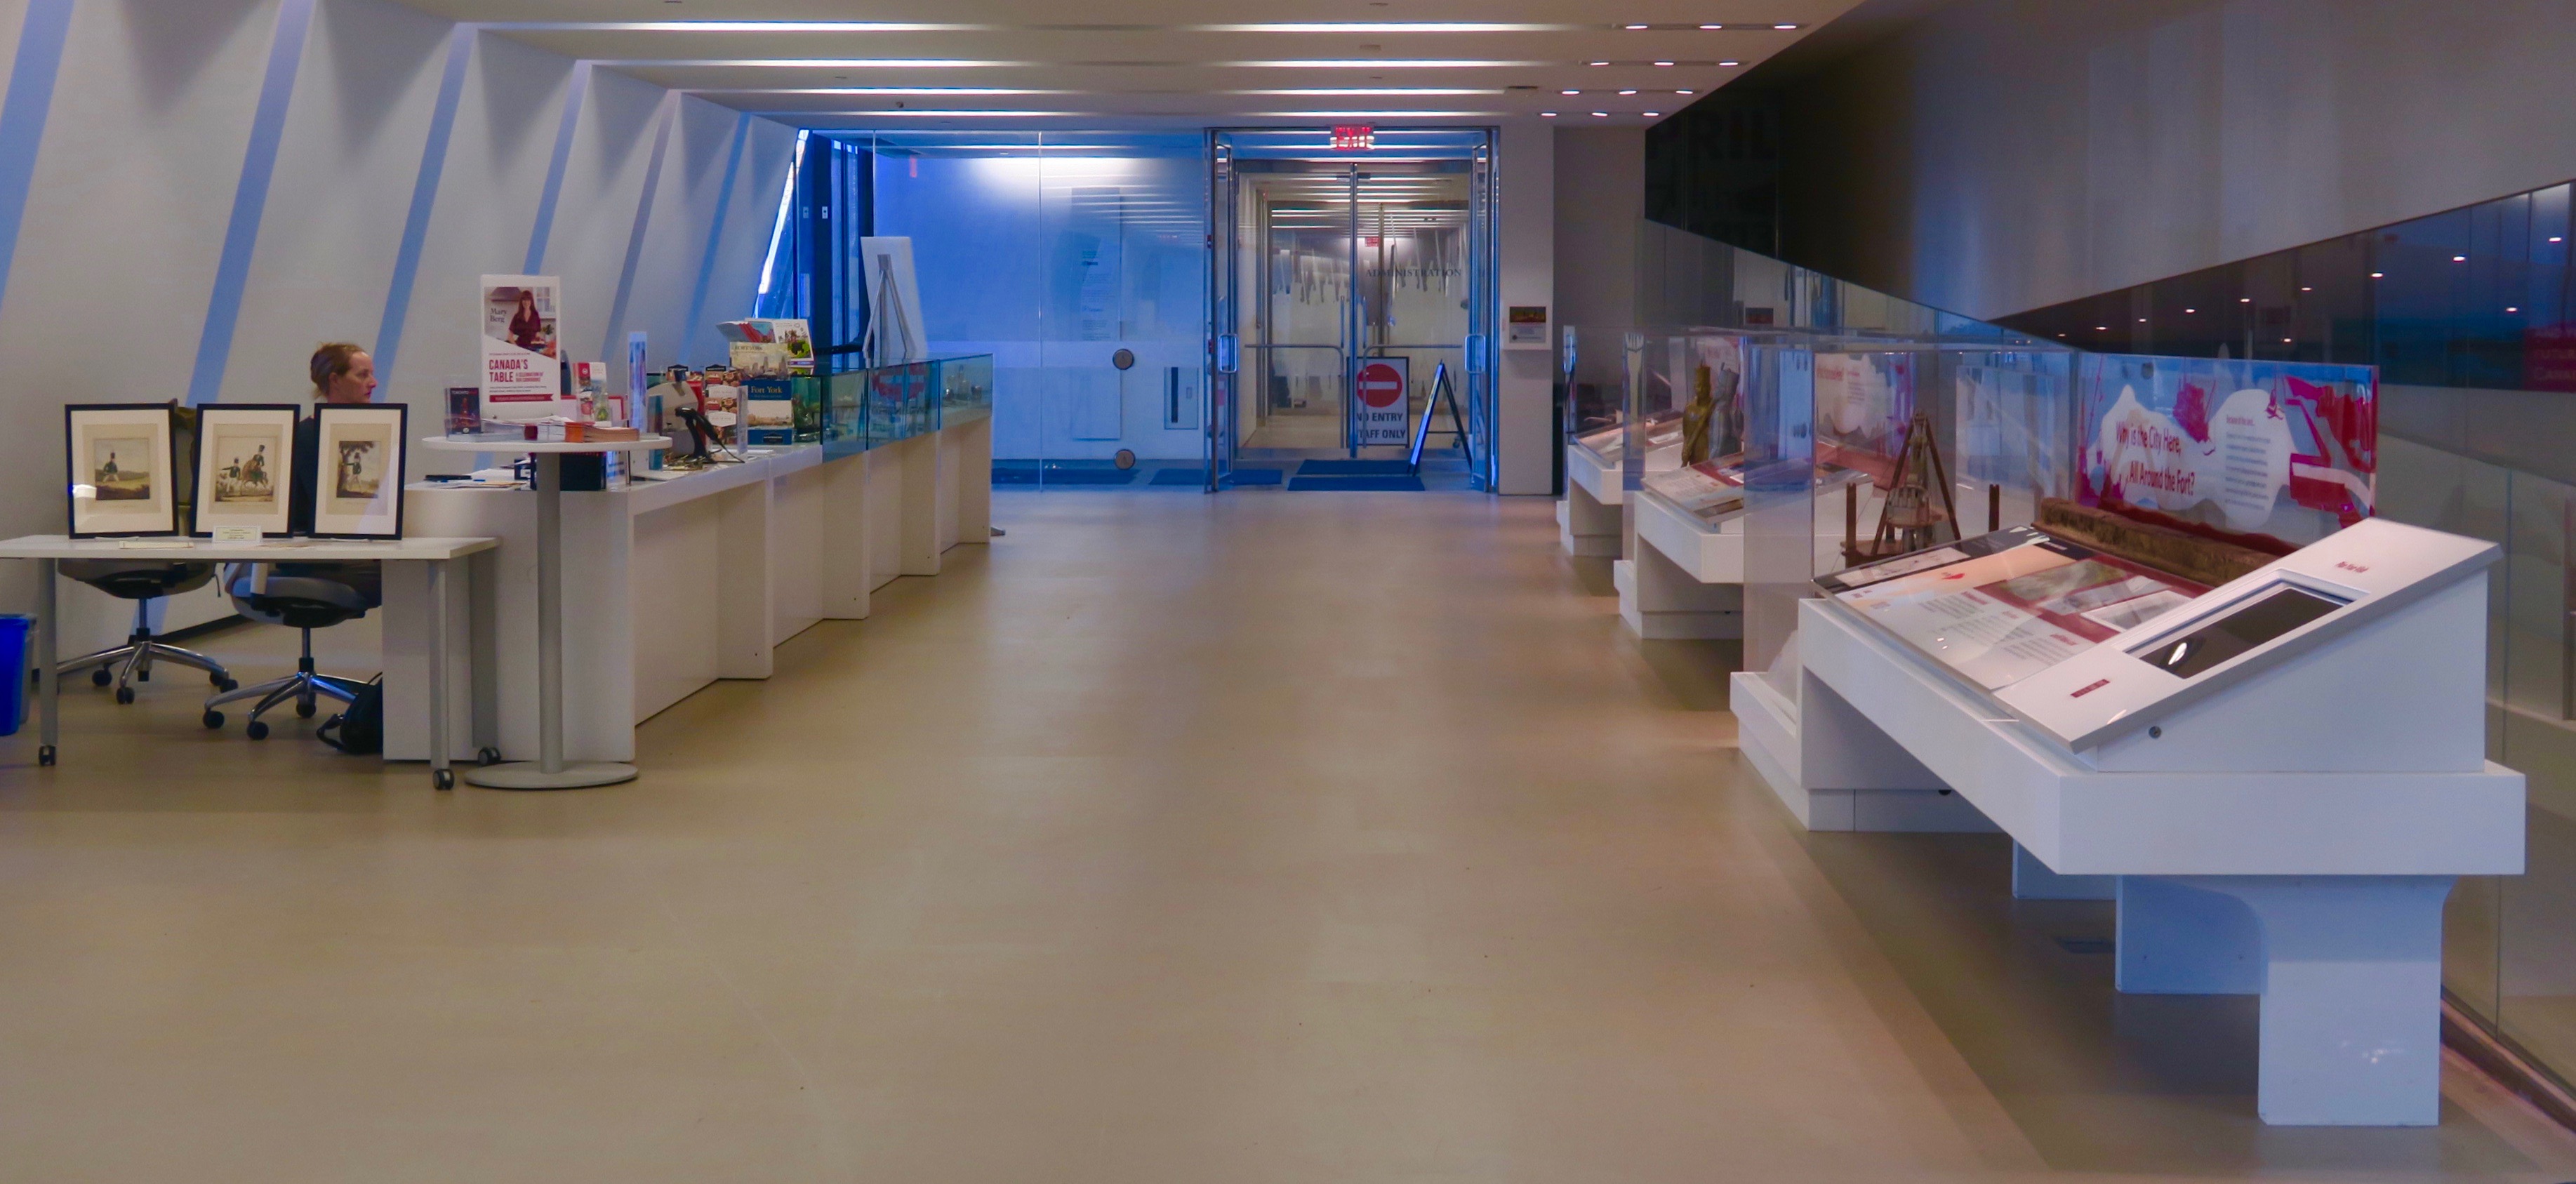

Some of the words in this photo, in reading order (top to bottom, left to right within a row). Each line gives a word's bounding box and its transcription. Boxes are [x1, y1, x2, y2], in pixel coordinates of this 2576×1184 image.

[1367, 268, 1461, 277] ADMINISTRATION
[489, 359, 528, 370] CANADA'S
[489, 372, 513, 383] TABLE
[1372, 413, 1403, 421] ENTRY
[1359, 430, 1379, 438] TAFF
[1382, 430, 1406, 438] ONLY
[2116, 421, 2130, 449] Why
[2130, 423, 2137, 446] is
[2137, 423, 2149, 448] the
[2149, 425, 2163, 455] City
[2163, 427, 2182, 457] Here,
[2129, 460, 2139, 483] All
[2139, 463, 2163, 489] Around
[2163, 466, 2175, 492] the
[2177, 469, 2196, 496] Fort?
